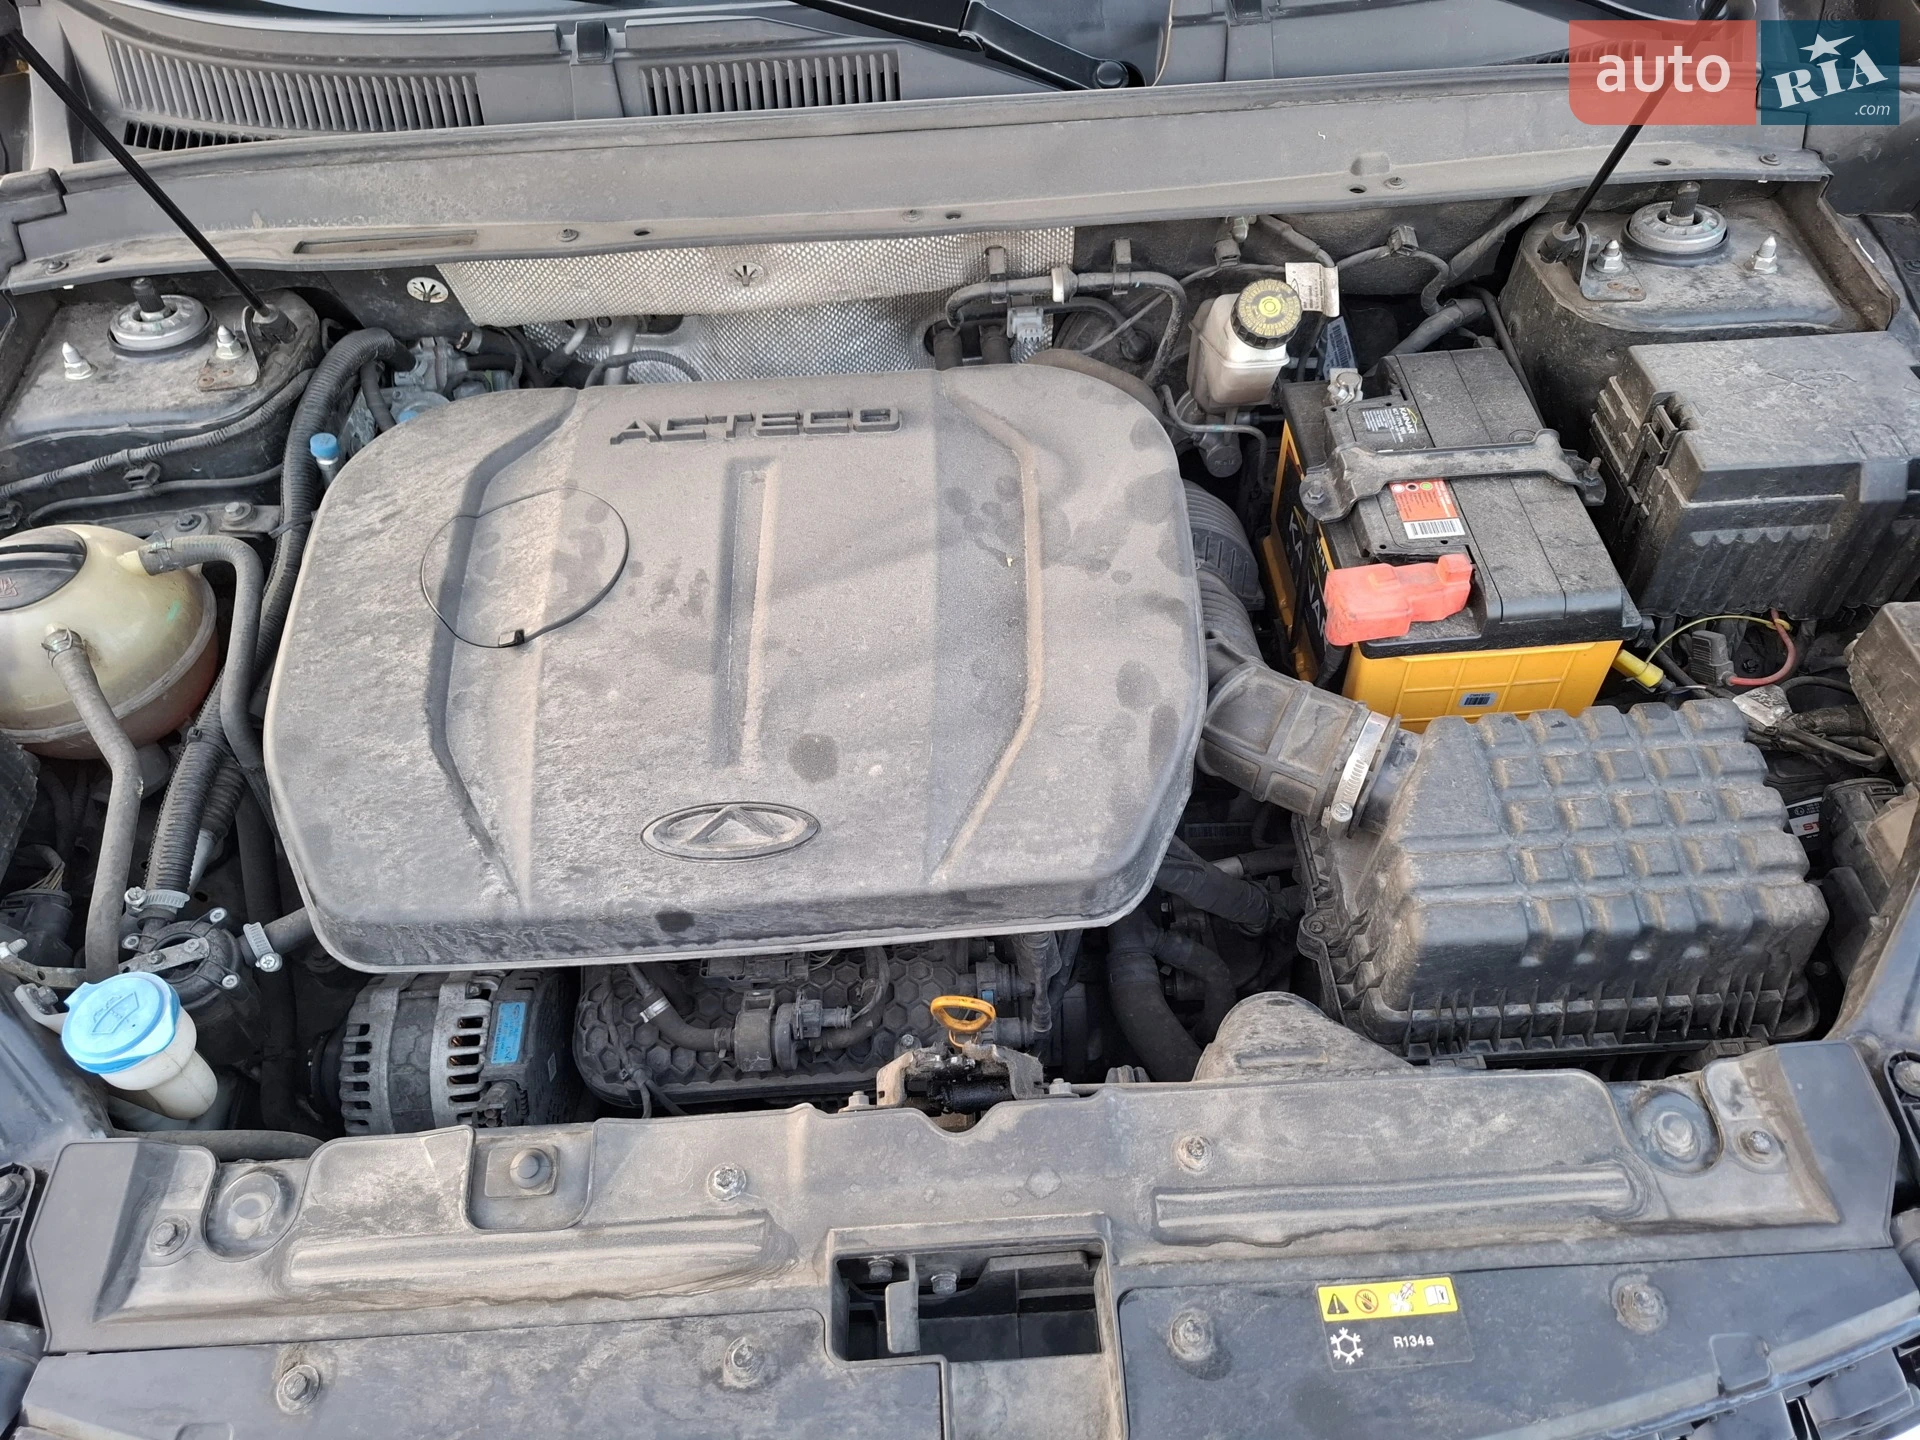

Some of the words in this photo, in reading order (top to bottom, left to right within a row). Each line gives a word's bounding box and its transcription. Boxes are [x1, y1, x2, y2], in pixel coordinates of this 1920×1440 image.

[610, 406, 901, 445] ACTECO
[1399, 407, 1416, 434] KAINAR
[1393, 1334, 1434, 1349] R134a
